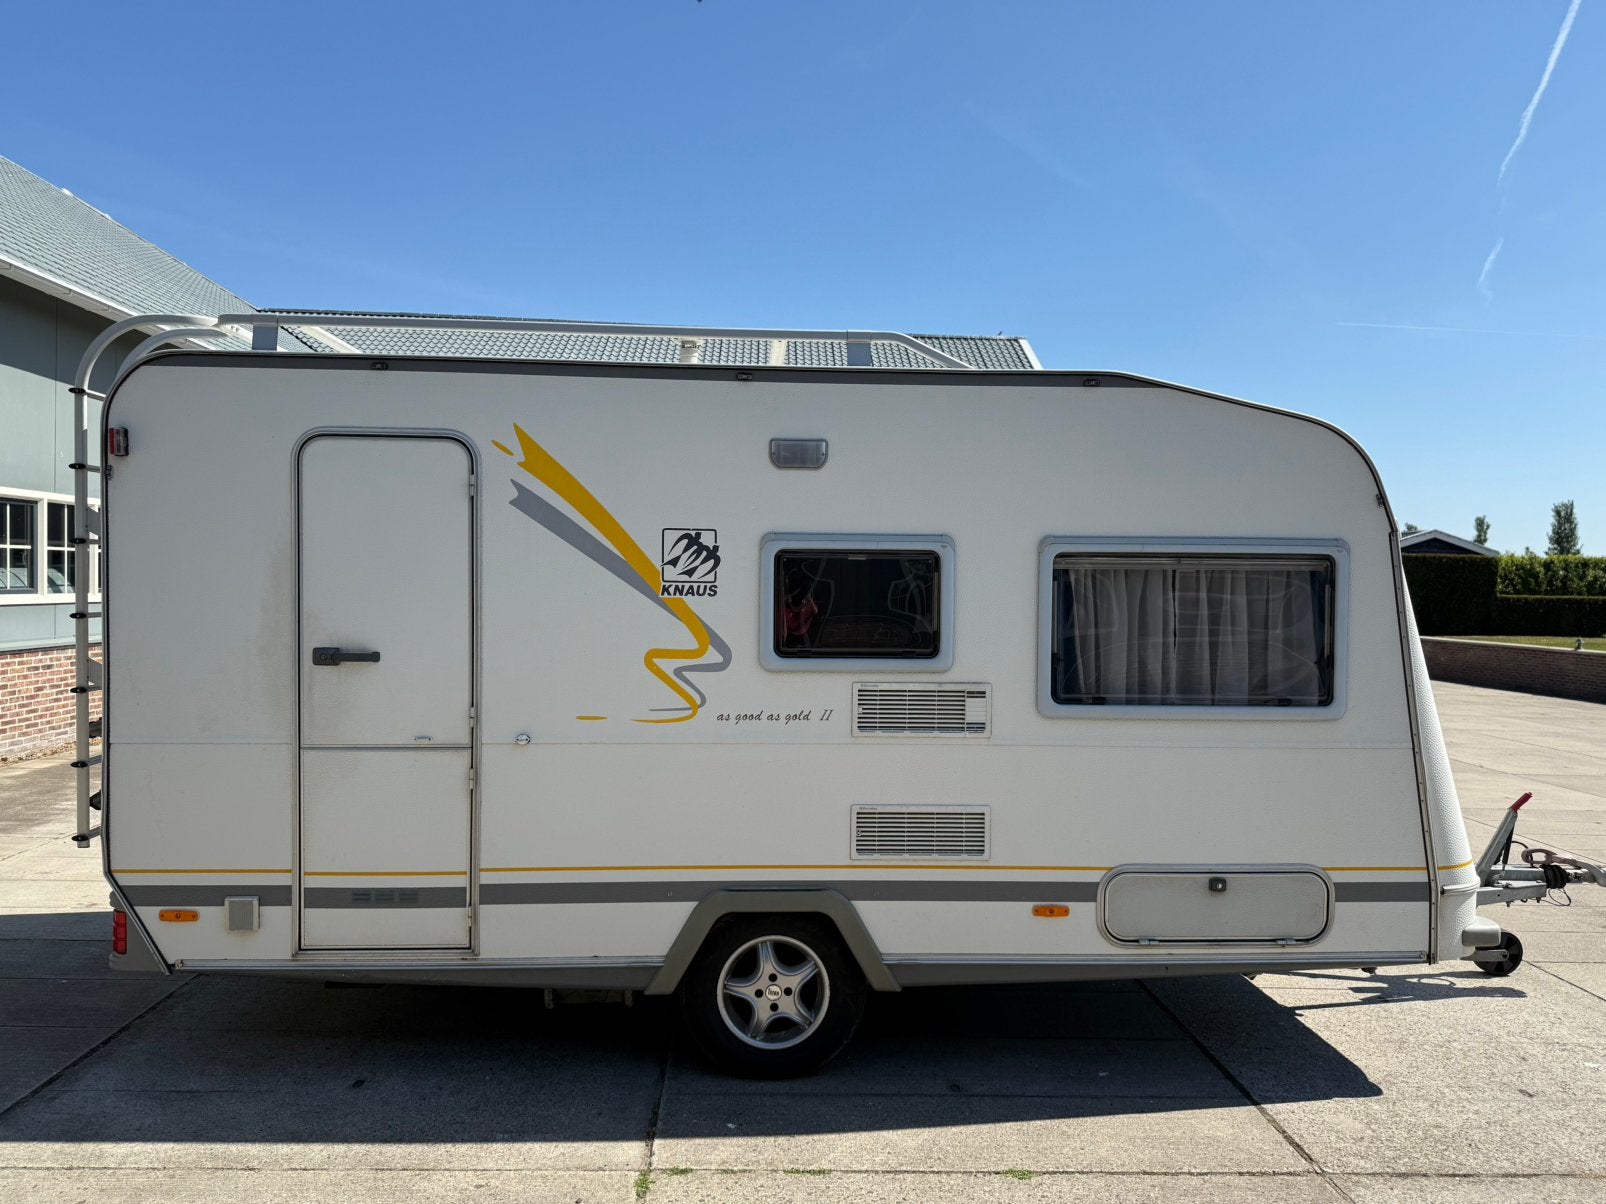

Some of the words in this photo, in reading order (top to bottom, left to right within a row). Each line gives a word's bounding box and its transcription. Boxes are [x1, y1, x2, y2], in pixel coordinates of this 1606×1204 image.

[661, 584, 718, 597] KNAUS
[716, 713, 731, 721] as
[735, 710, 764, 725] good
[766, 713, 781, 721] as
[785, 710, 812, 725] gold
[820, 709, 834, 721] II
